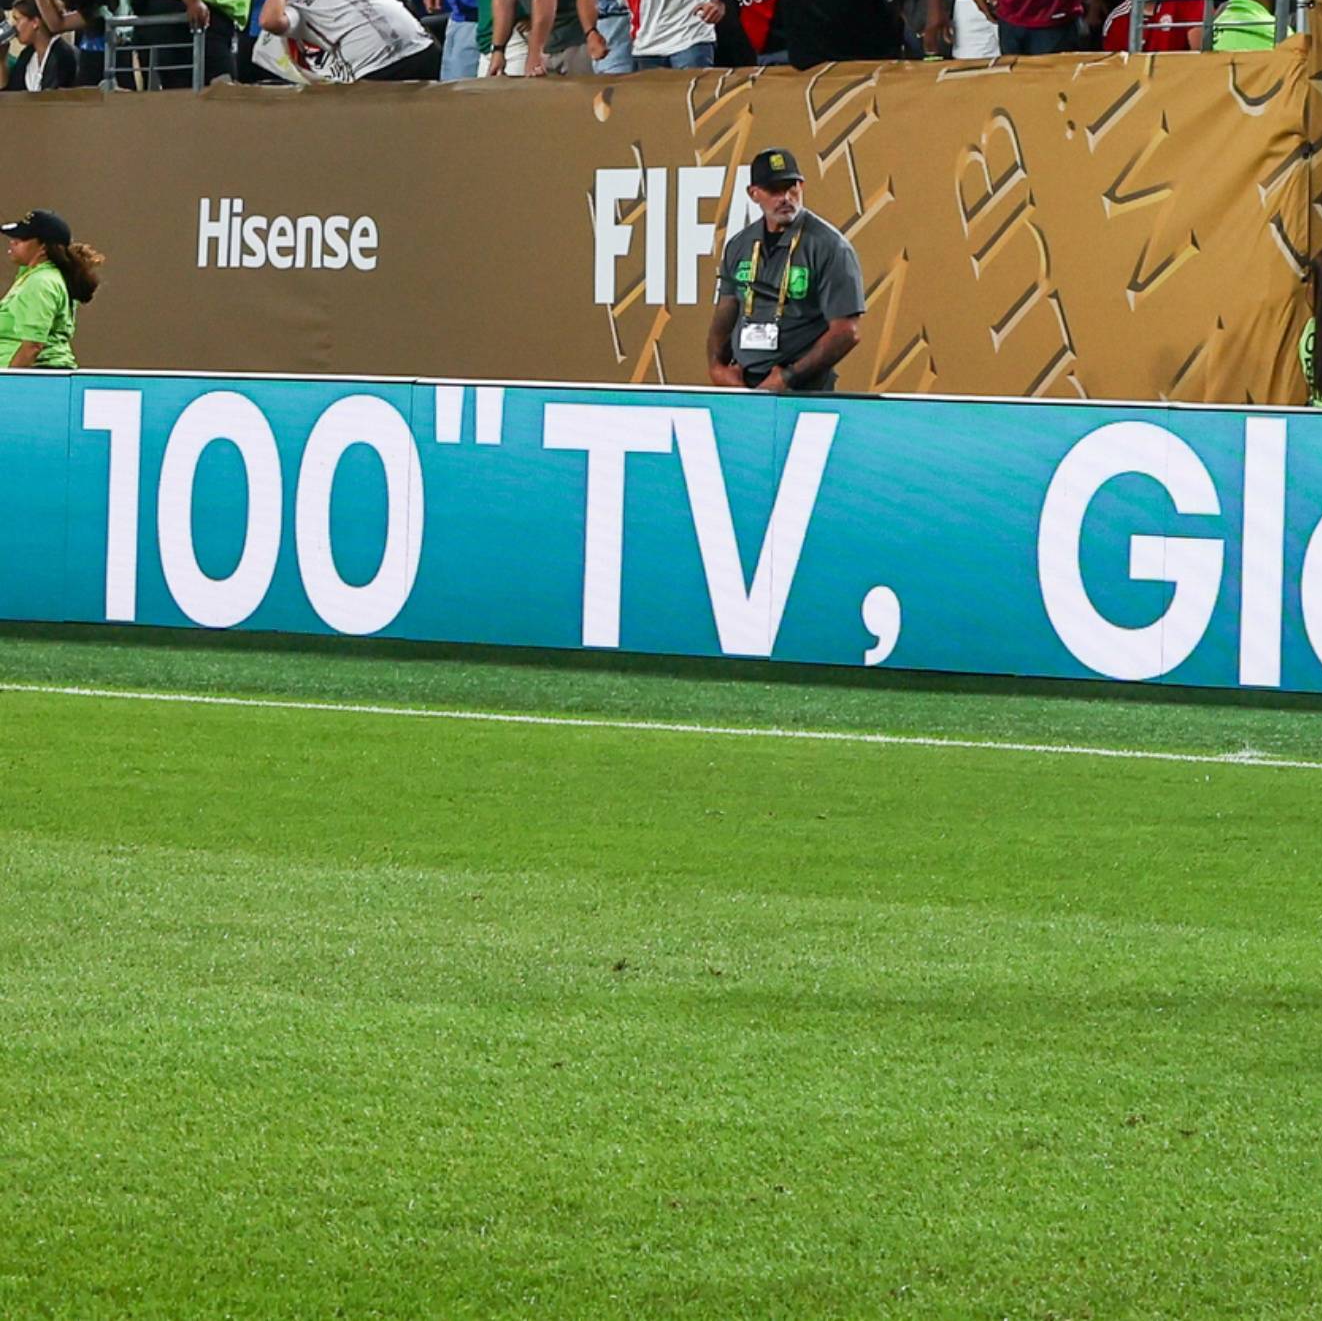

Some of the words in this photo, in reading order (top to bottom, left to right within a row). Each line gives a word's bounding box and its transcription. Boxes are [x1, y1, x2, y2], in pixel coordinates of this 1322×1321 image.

[197, 197, 378, 271] Hisense
[84, 386, 504, 636] 100"
[544, 404, 902, 667] TV,
